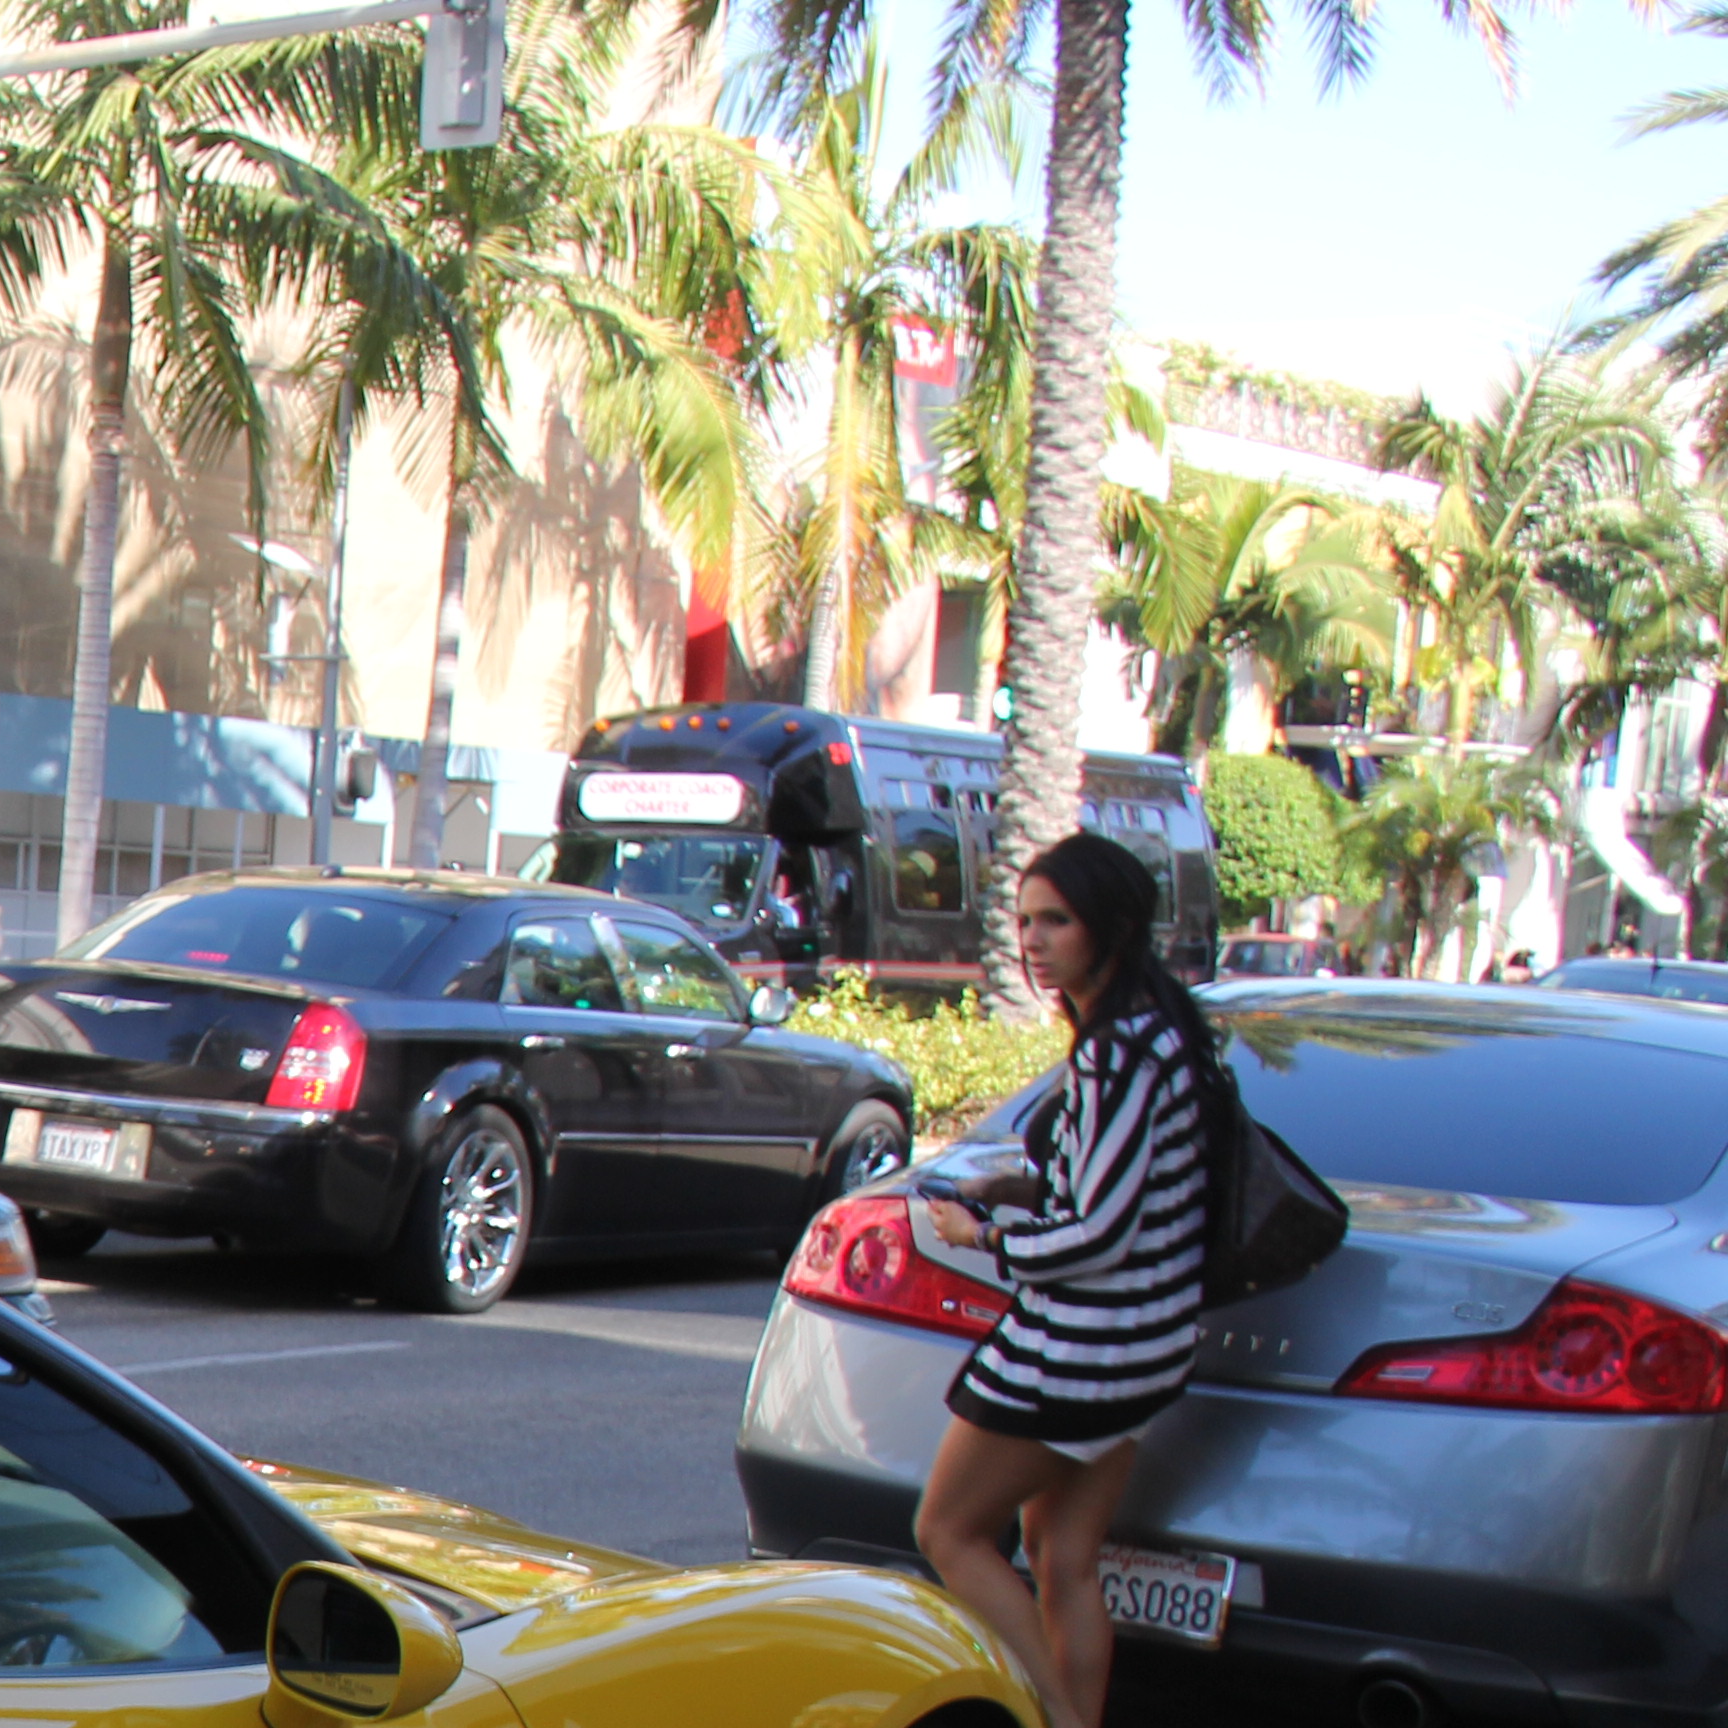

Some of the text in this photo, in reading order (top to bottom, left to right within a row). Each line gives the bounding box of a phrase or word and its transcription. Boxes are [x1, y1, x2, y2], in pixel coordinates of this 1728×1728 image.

[588, 779, 734, 795] CORPORATE COACH
[625, 799, 690, 814] CHARTER
[1100, 1572, 1215, 1631] GS088
